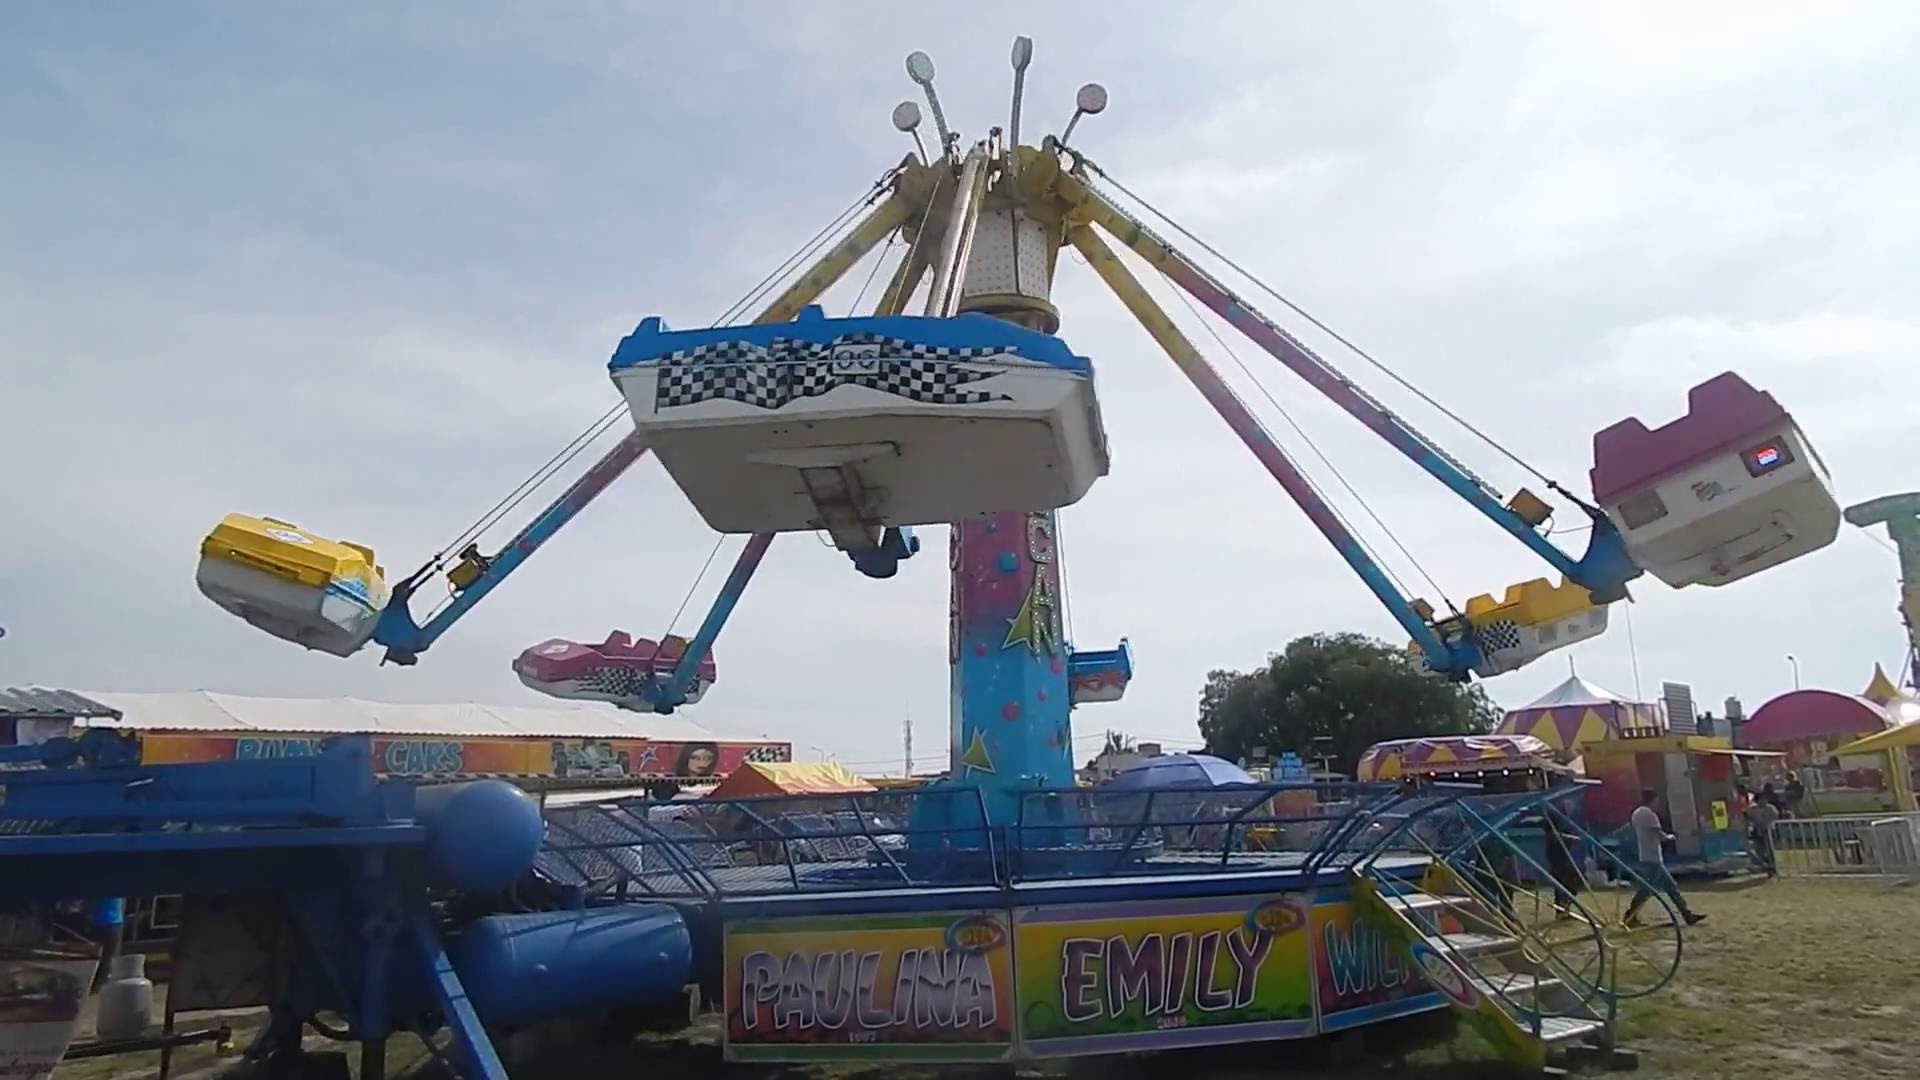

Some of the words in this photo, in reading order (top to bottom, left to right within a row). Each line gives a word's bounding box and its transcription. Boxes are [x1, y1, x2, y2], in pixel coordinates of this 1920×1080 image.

[385, 739, 463, 776] CARS
[742, 947, 998, 1030] PAULINA
[1062, 924, 1274, 1022] EMILY
